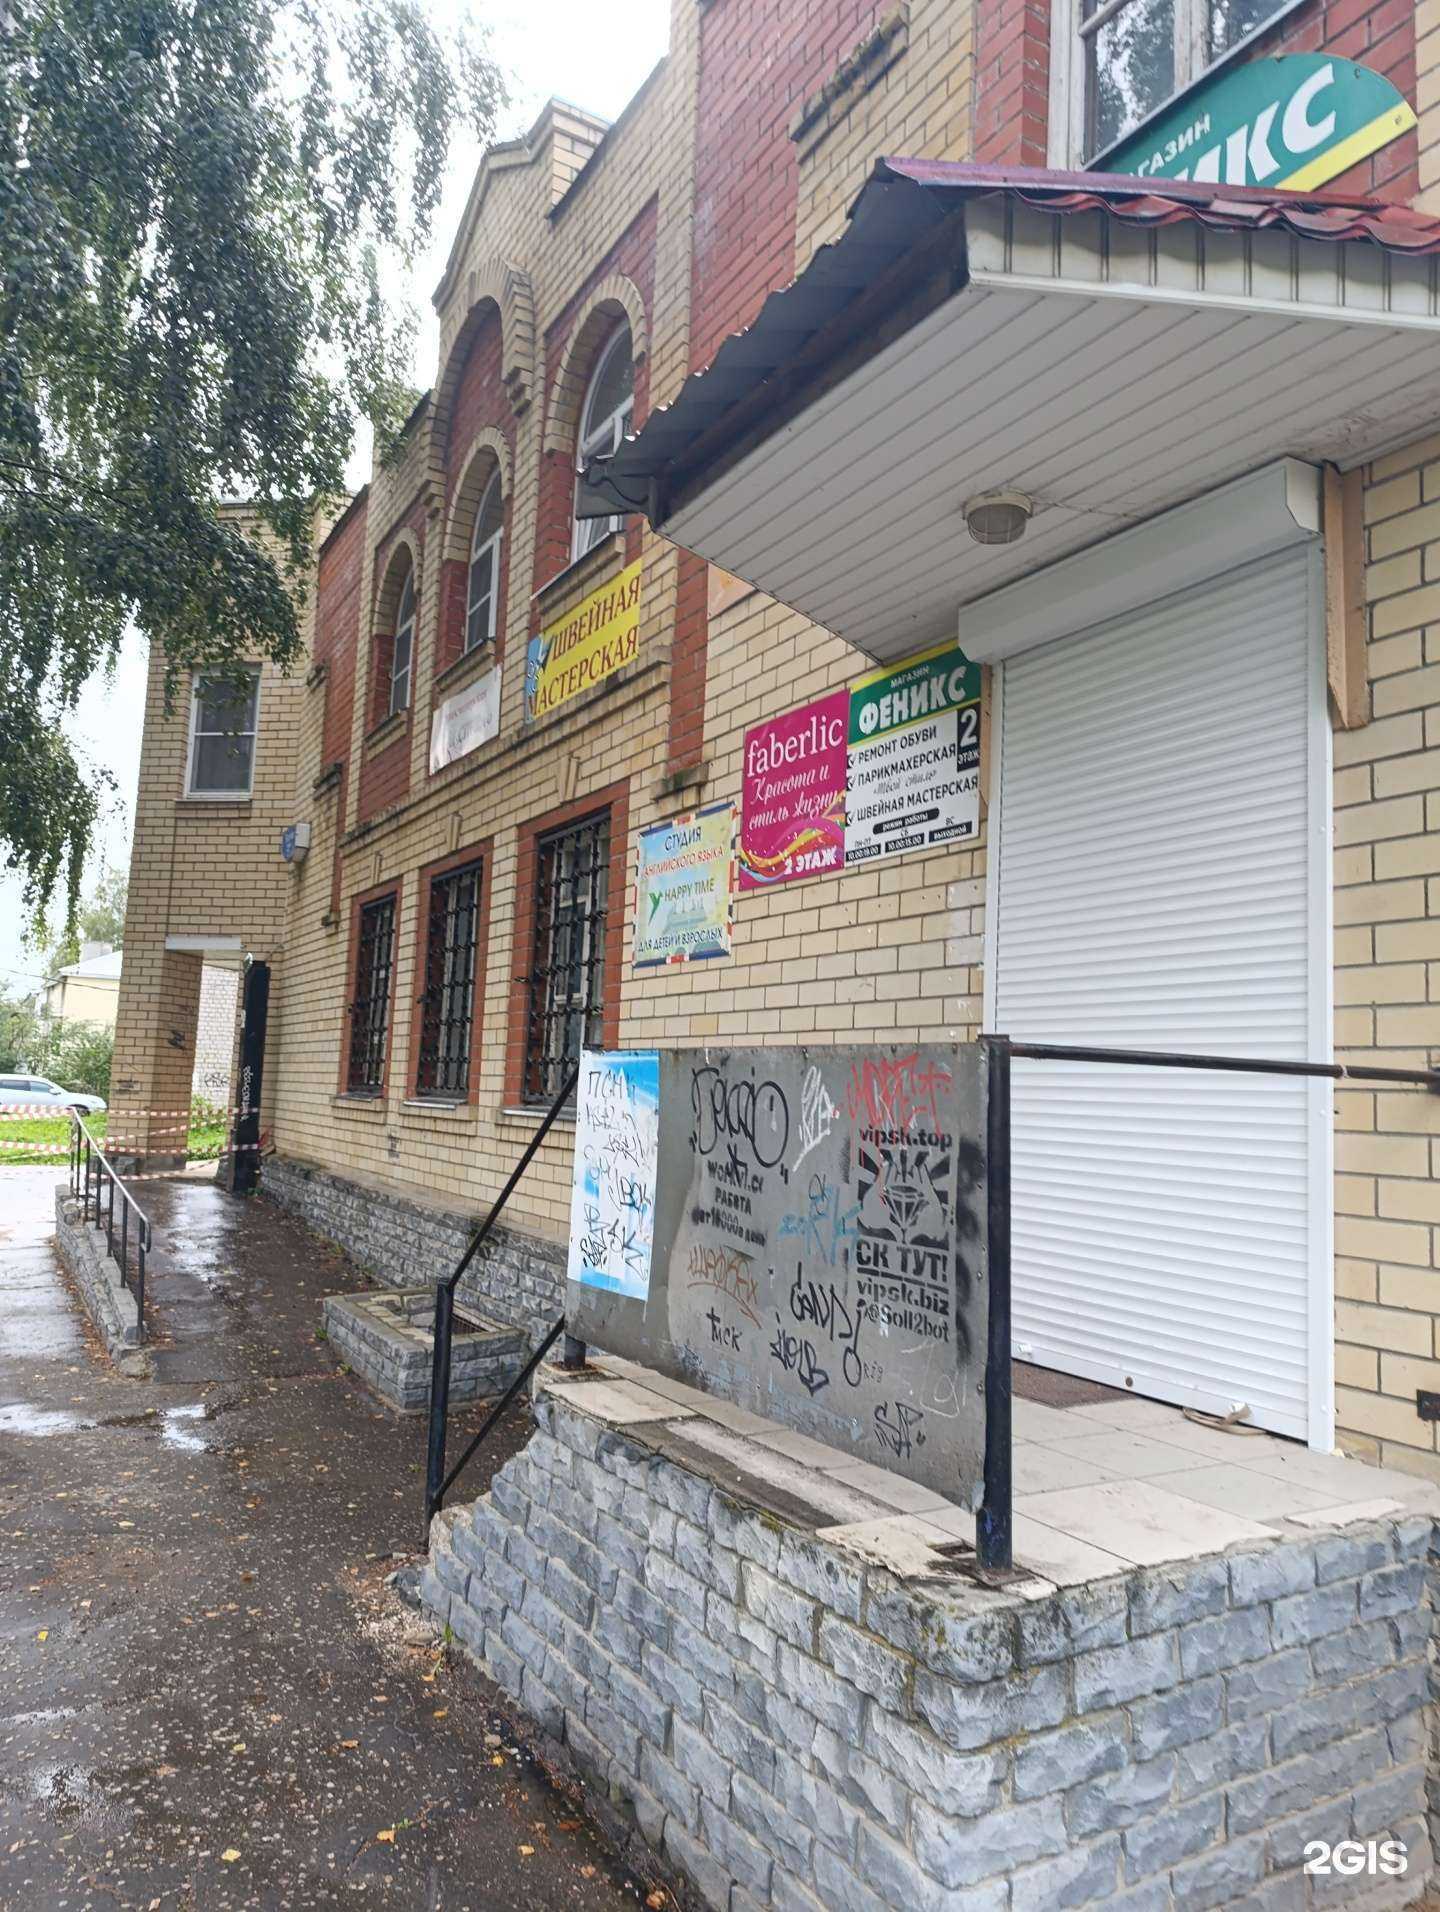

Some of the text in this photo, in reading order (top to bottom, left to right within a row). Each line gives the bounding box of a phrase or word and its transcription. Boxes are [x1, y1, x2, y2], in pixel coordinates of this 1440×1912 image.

[1129, 113, 1211, 178] ГАЗИН
[551, 575, 642, 662] ШВЕЙНАЯ
[528, 626, 640, 717] МАСТЕРСКАЯ
[858, 665, 967, 735] ФЕНИКС
[747, 714, 843, 778] faberlic
[858, 725, 937, 765] РЕМОНТ ОБУВИ
[959, 708, 978, 747] 2
[750, 764, 830, 806] Красота и
[857, 742, 957, 786] ПАРИКМАХЕРСКАЯ
[749, 805, 790, 831] стиль
[857, 774, 979, 822] ШВЕЙНАЯ МАСТЕРСКАЯ
[664, 826, 702, 851] СТУДИЯ
[784, 845, 838, 876] 2 ЭТАЖ
[664, 877, 715, 902] HAPPY TIME
[856, 1277, 950, 1316] vipsk.biz
